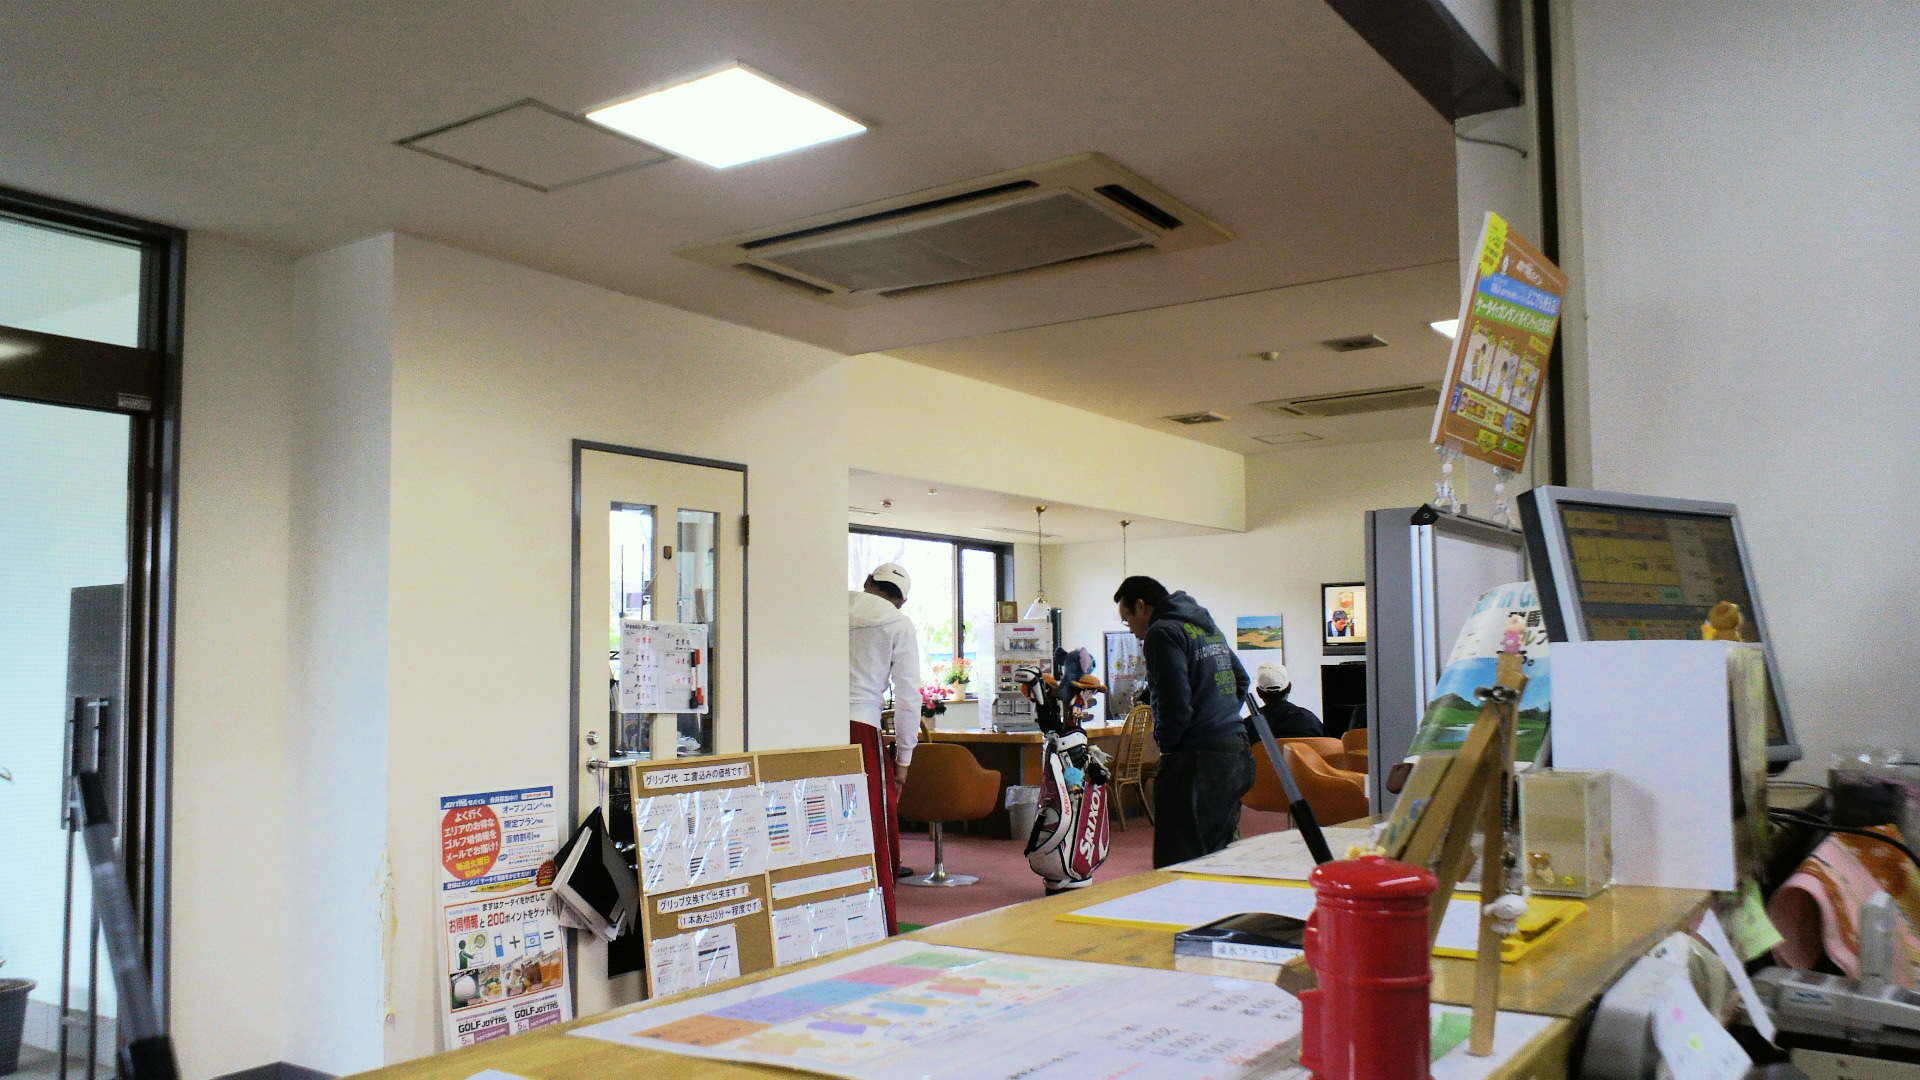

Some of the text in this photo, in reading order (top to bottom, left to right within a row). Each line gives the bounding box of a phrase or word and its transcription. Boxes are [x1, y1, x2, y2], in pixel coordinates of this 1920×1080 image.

[454, 808, 483, 823] よく行く
[443, 817, 496, 838] エリアのお得な
[443, 829, 497, 850] ゴルフ場情報を
[445, 841, 499, 863] メールでお届け!
[482, 892, 546, 911] まずはケータイをかざして
[514, 1006, 536, 1019] GOLF
[458, 1020, 481, 1034] GOLF
